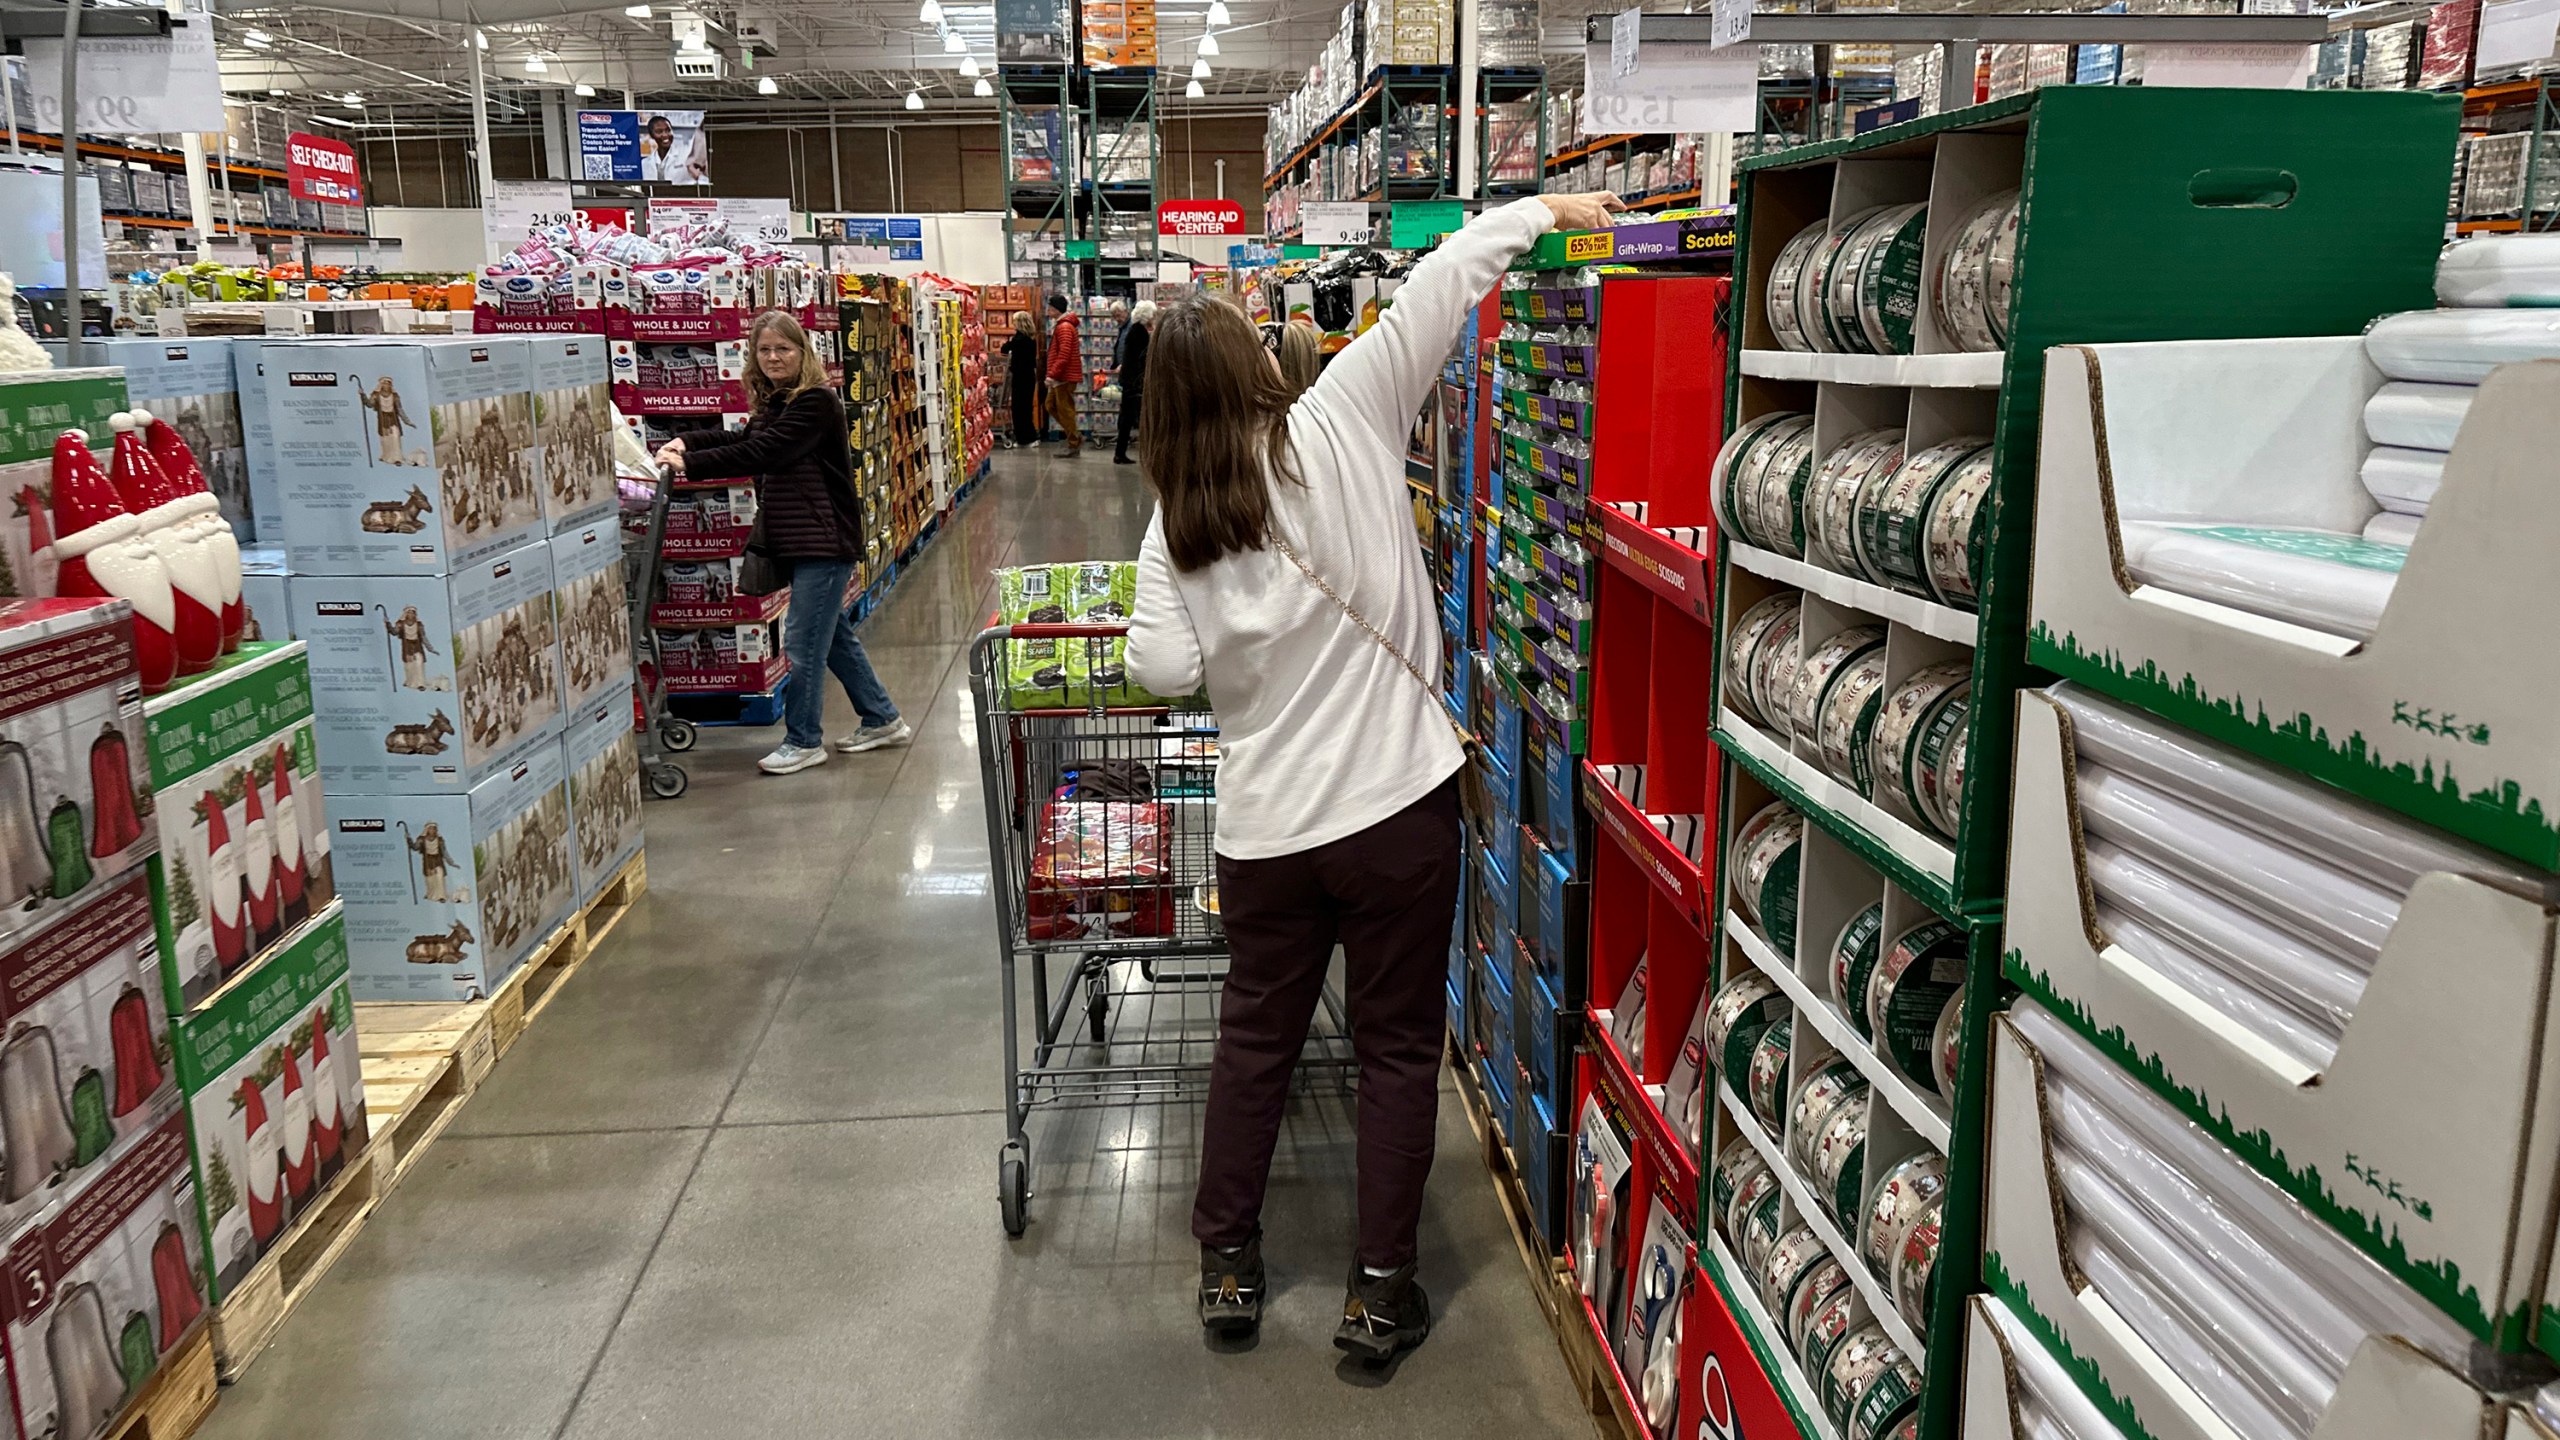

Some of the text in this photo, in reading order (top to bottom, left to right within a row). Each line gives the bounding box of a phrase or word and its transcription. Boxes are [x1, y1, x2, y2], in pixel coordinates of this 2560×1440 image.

[291, 144, 354, 174] SELF CHECK-OUT
[531, 213, 572, 227] 24.99
[1162, 211, 1238, 222] HEARING AID
[759, 227, 788, 239] 5.99
[1176, 223, 1224, 233] CENTER
[1340, 231, 1367, 243] 9.49
[1570, 235, 1608, 253] 65% MORE
[1594, 243, 1608, 251] TAPE
[1618, 242, 1663, 255] Gift-Wrap
[1566, 302, 1584, 318] Scotch
[496, 322, 534, 331] WHOLE
[536, 322, 544, 331] &
[545, 322, 574, 331] JUICY
[633, 321, 711, 329] WHOLE & JUICY
[1565, 355, 1584, 373] Scotch
[643, 396, 680, 404] WHOLE
[693, 396, 721, 405] JUICY
[1559, 412, 1575, 429] Scotch
[1561, 467, 1577, 485] Scotch
[1566, 519, 1582, 538] Scotch
[1585, 516, 1604, 541] Scotch
[695, 539, 702, 547] &
[704, 539, 732, 547] JUICY
[1605, 533, 1685, 591] PRECISION ULTRA EDGE SCISSORS
[1561, 570, 1578, 592] Scotch
[657, 609, 693, 617] WHOLE
[1556, 623, 1571, 642] Scotch
[664, 676, 698, 684] WHOLE
[709, 675, 736, 683] JUICY
[1553, 675, 1569, 694] Scotch
[1656, 859, 1682, 896] SCISSORS
[24, 1269, 46, 1308] 3
